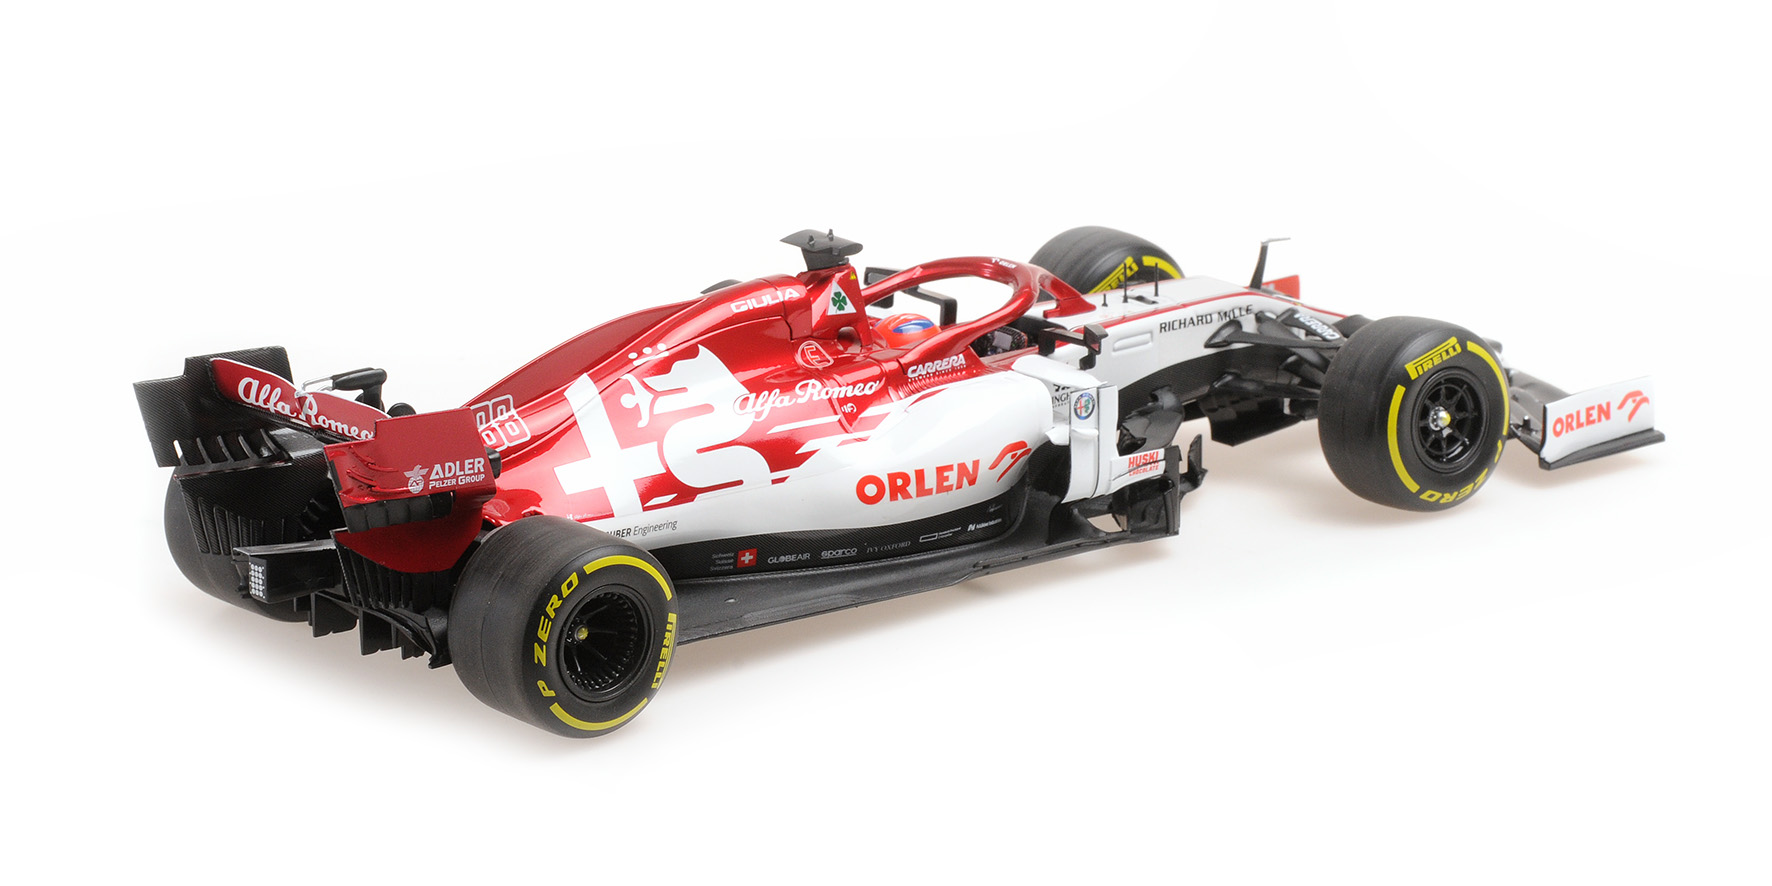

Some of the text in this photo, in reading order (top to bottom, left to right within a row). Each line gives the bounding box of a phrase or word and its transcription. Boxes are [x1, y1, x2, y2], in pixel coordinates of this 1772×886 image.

[730, 288, 801, 314] GIULIA
[1159, 314, 1213, 334] RICHARD
[907, 353, 966, 378] CARRERA
[1404, 336, 1462, 381] PIRELLI
[237, 377, 374, 440] Alfa Romeo
[732, 379, 880, 422] Alfa Romeo
[1552, 400, 1612, 438] ORLEN
[429, 457, 485, 480] ADLER
[1128, 450, 1160, 469] HUSKI
[428, 473, 486, 490] PELZER GROUP
[855, 459, 980, 506] ORLEN
[633, 520, 678, 537] Engineering
[767, 552, 811, 565] GLOBEAIR
[820, 547, 858, 559] sparco
[533, 572, 579, 667] ZERO
[651, 612, 677, 689] PIRELLI
